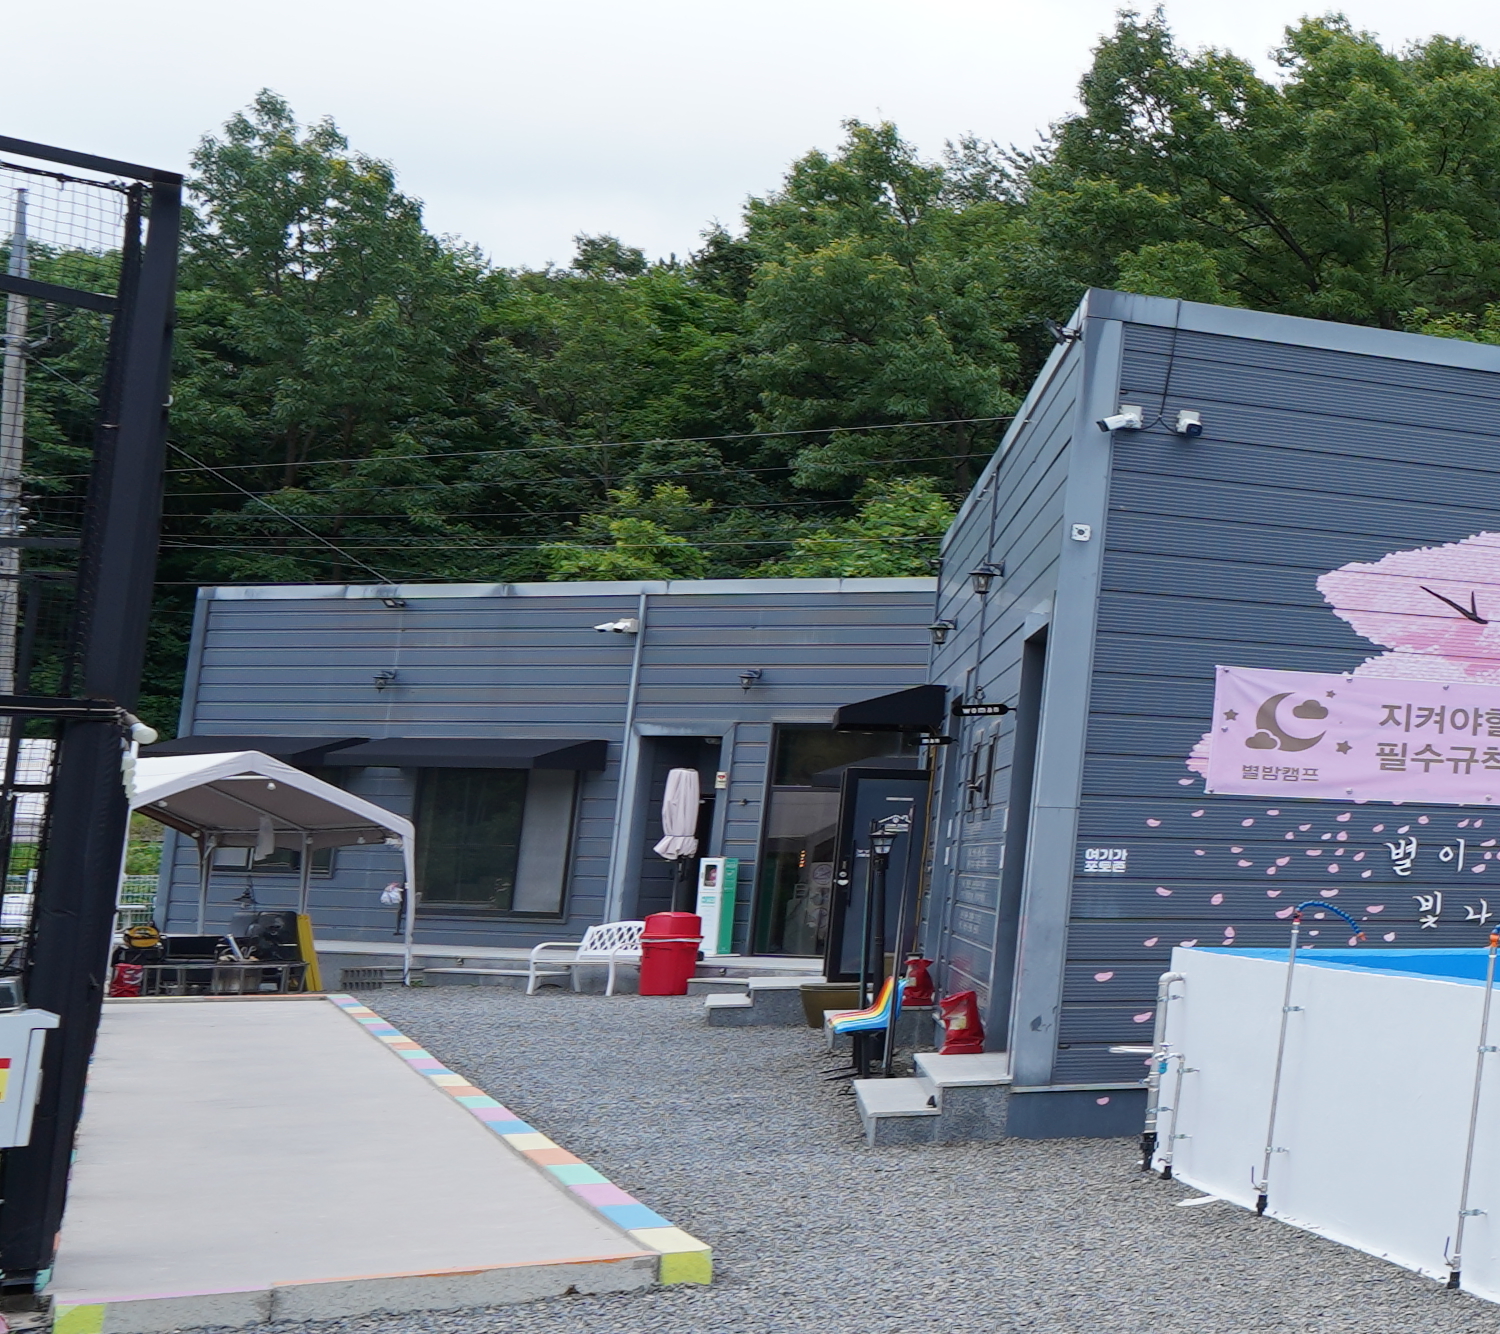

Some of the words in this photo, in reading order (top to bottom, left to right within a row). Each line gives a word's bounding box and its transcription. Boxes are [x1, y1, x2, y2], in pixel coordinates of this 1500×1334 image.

[1242, 764, 1320, 782] 별밤캠프
[1085, 848, 1128, 861] 여기가
[1084, 860, 1126, 873] 포토존
